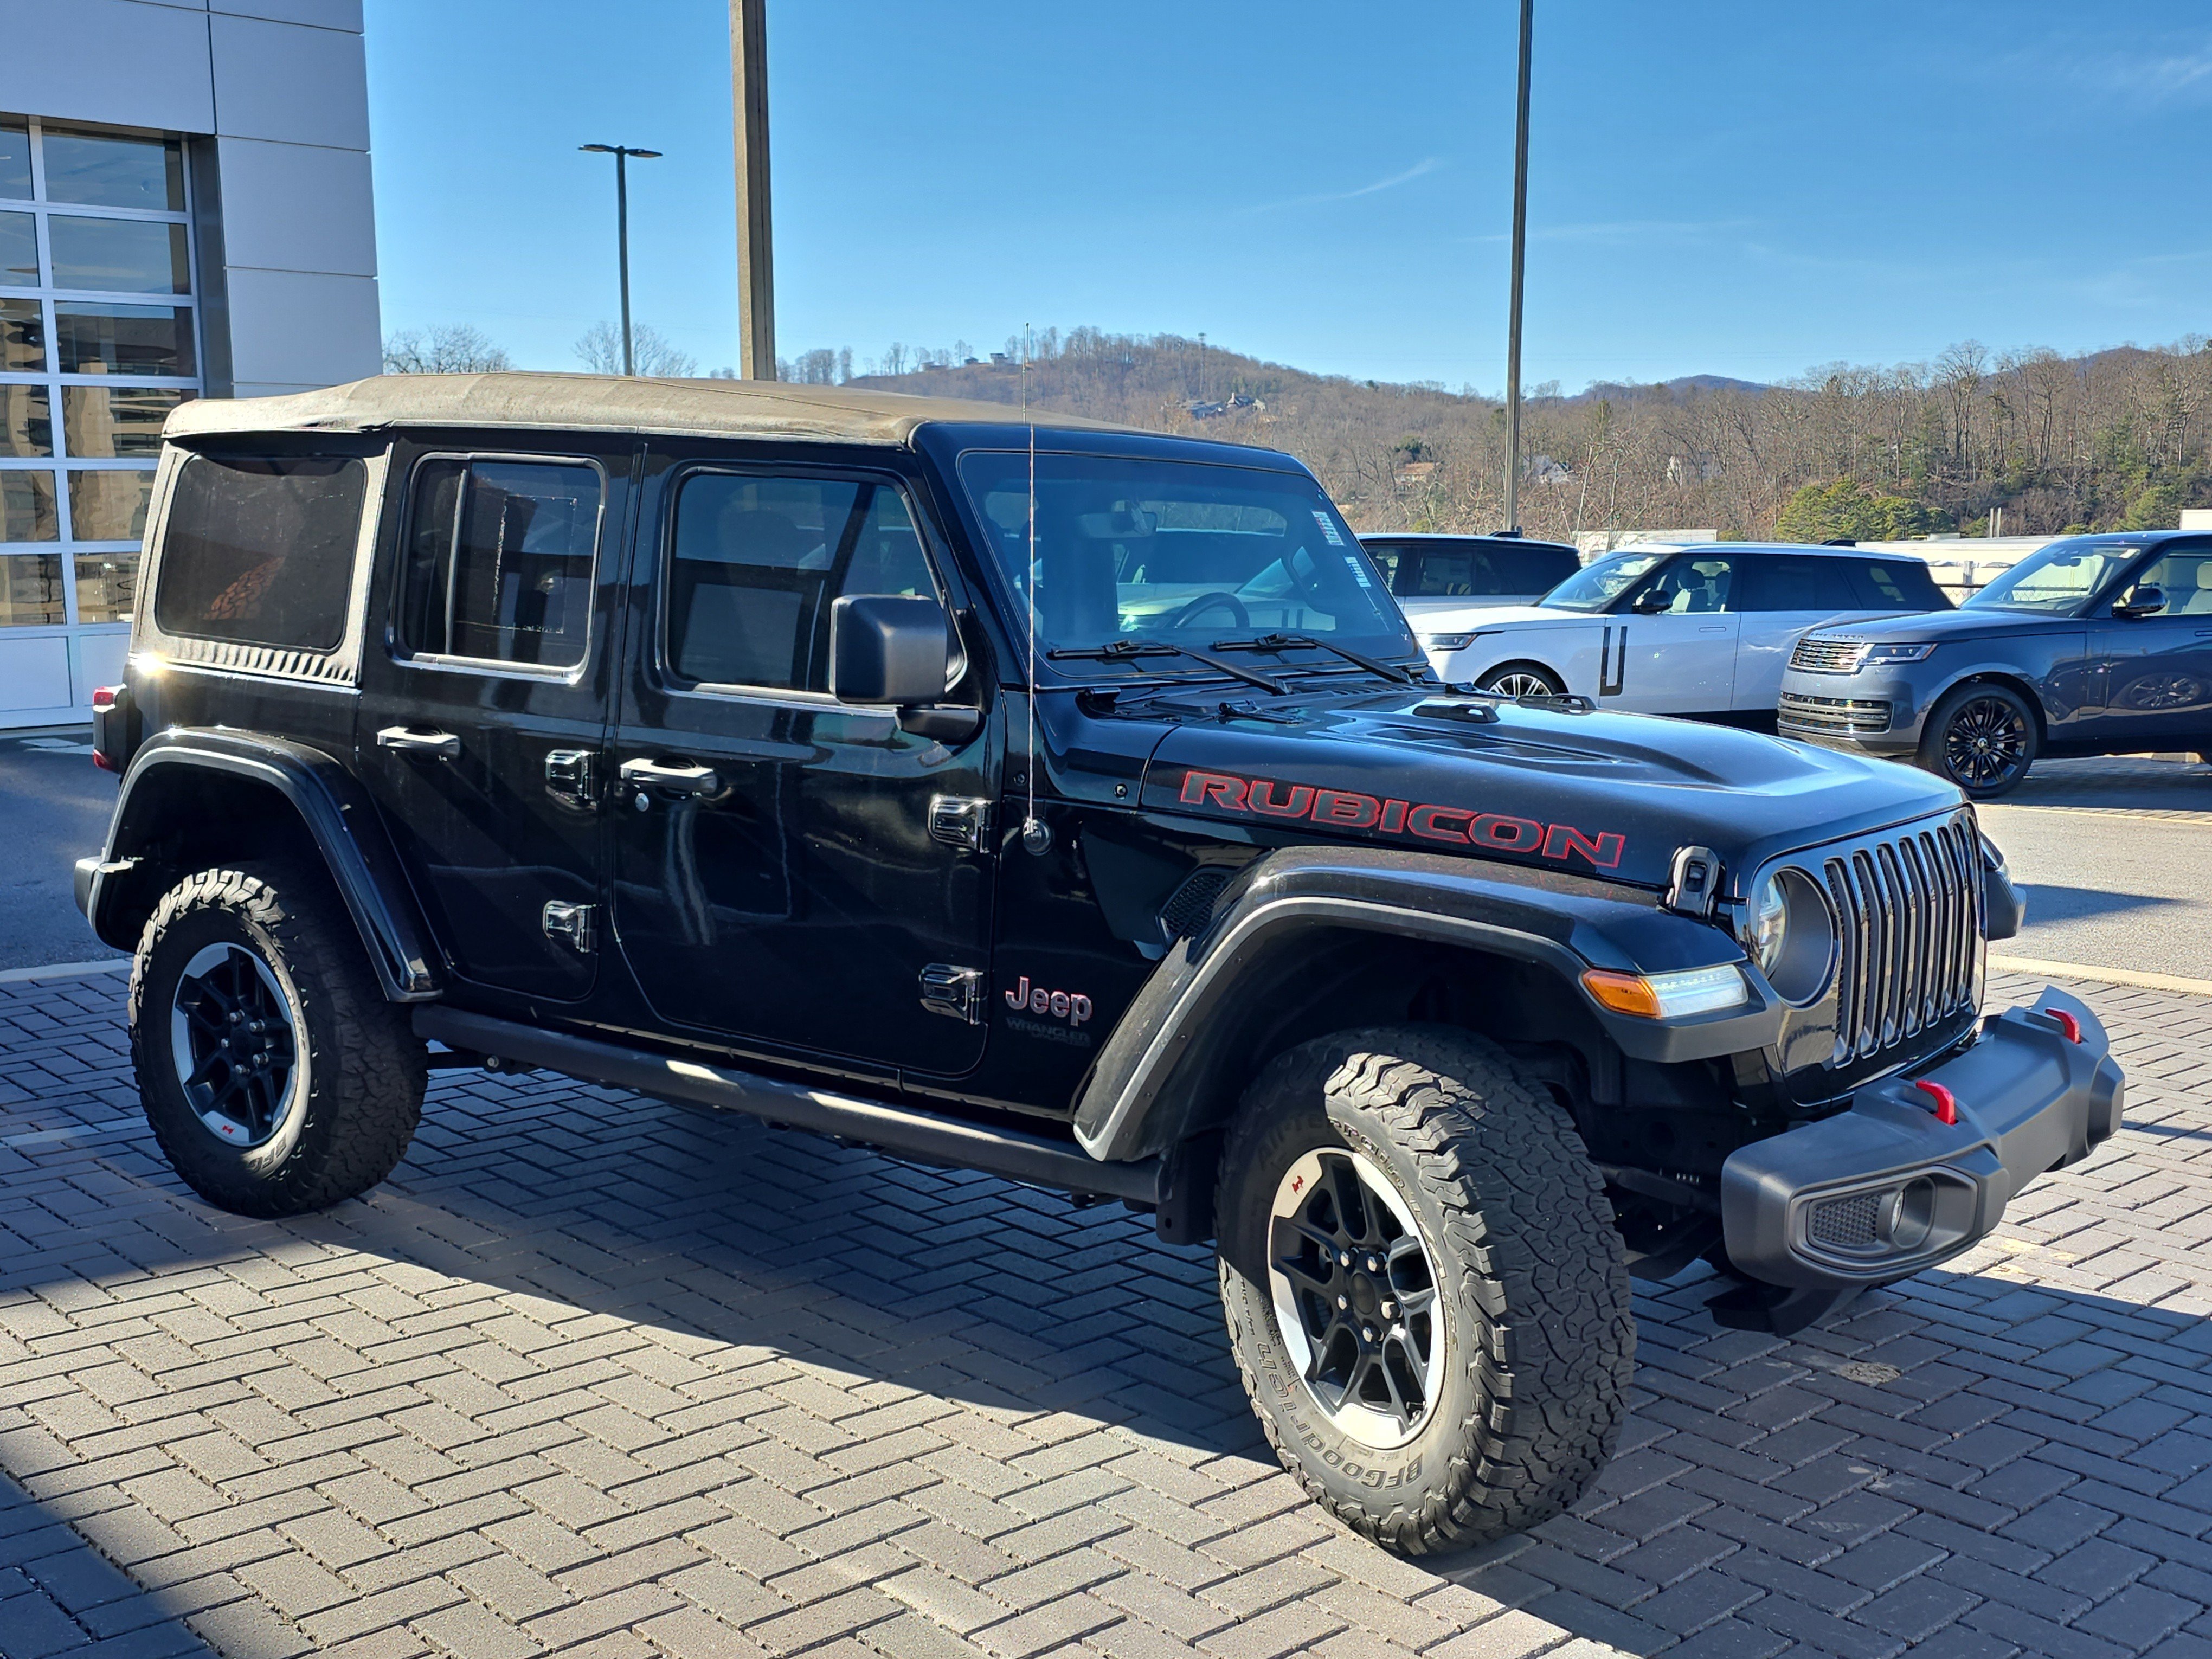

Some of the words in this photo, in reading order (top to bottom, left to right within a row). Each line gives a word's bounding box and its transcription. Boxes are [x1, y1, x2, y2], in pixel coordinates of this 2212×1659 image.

[1180, 771, 1625, 868] RUBICON
[1005, 976, 1092, 1027] Jeep
[1256, 1341, 1423, 1491] BFGoodrich
